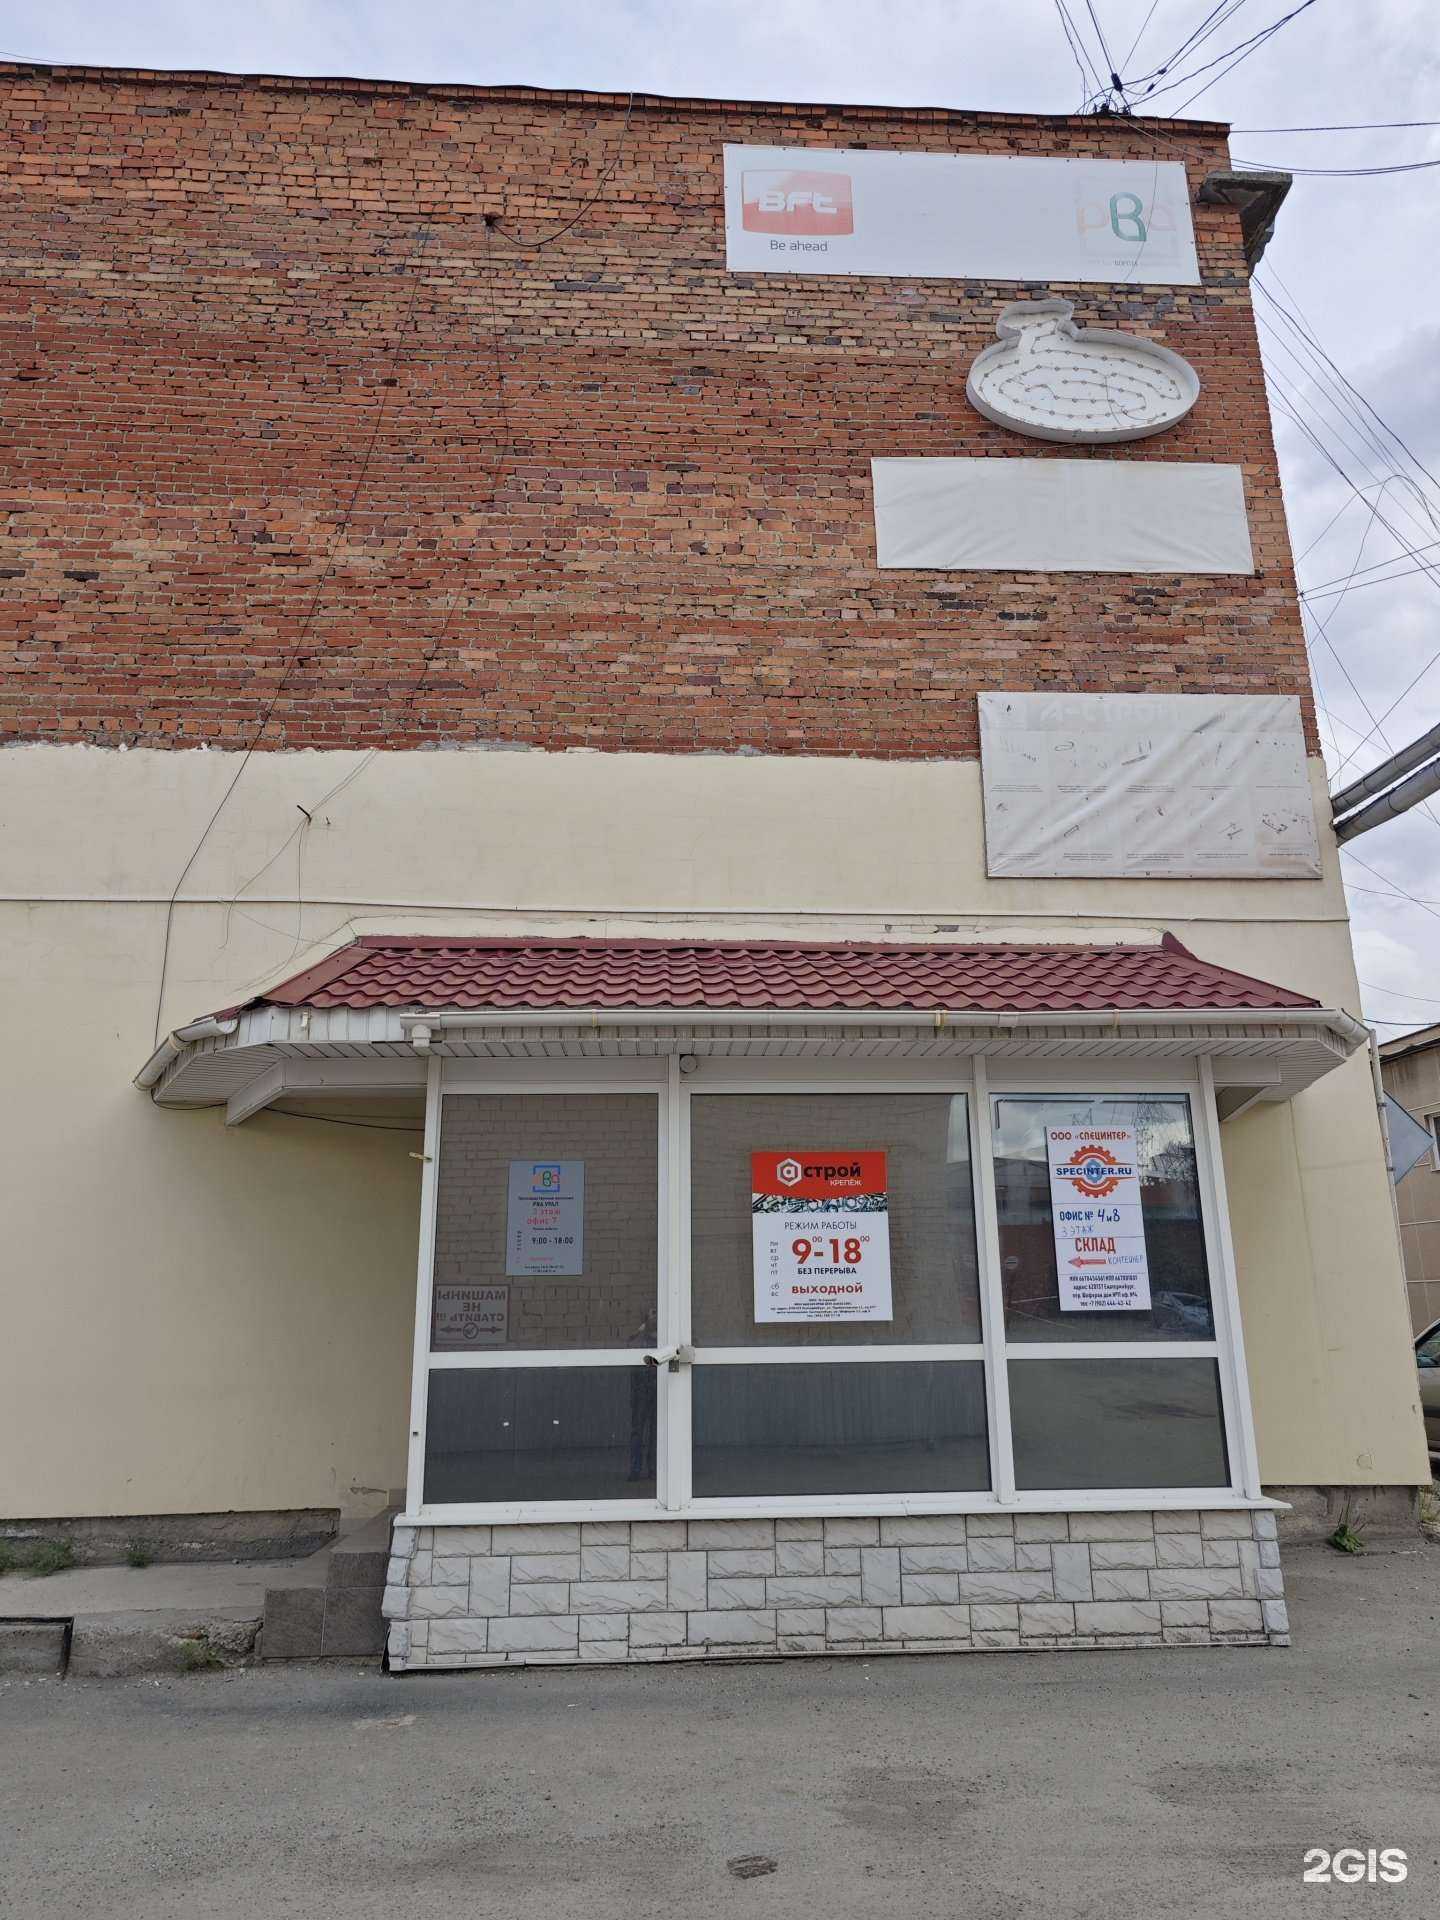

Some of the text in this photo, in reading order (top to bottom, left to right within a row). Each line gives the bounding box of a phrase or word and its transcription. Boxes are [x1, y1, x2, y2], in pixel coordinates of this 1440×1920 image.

[770, 240, 828, 252] Be ahead
[1050, 1132, 1072, 1141] ООО
[1055, 1167, 1132, 1176] SPECINTER.RU
[1060, 1211, 1083, 1221] ОФИС
[784, 1221, 857, 1231] РЕЖИМ РАБОТЫ
[1075, 1237, 1117, 1254] СКЛАД
[814, 1267, 857, 1275] ПЕРЕРЫВА
[791, 1282, 863, 1295] ВЫХОДНОЙ
